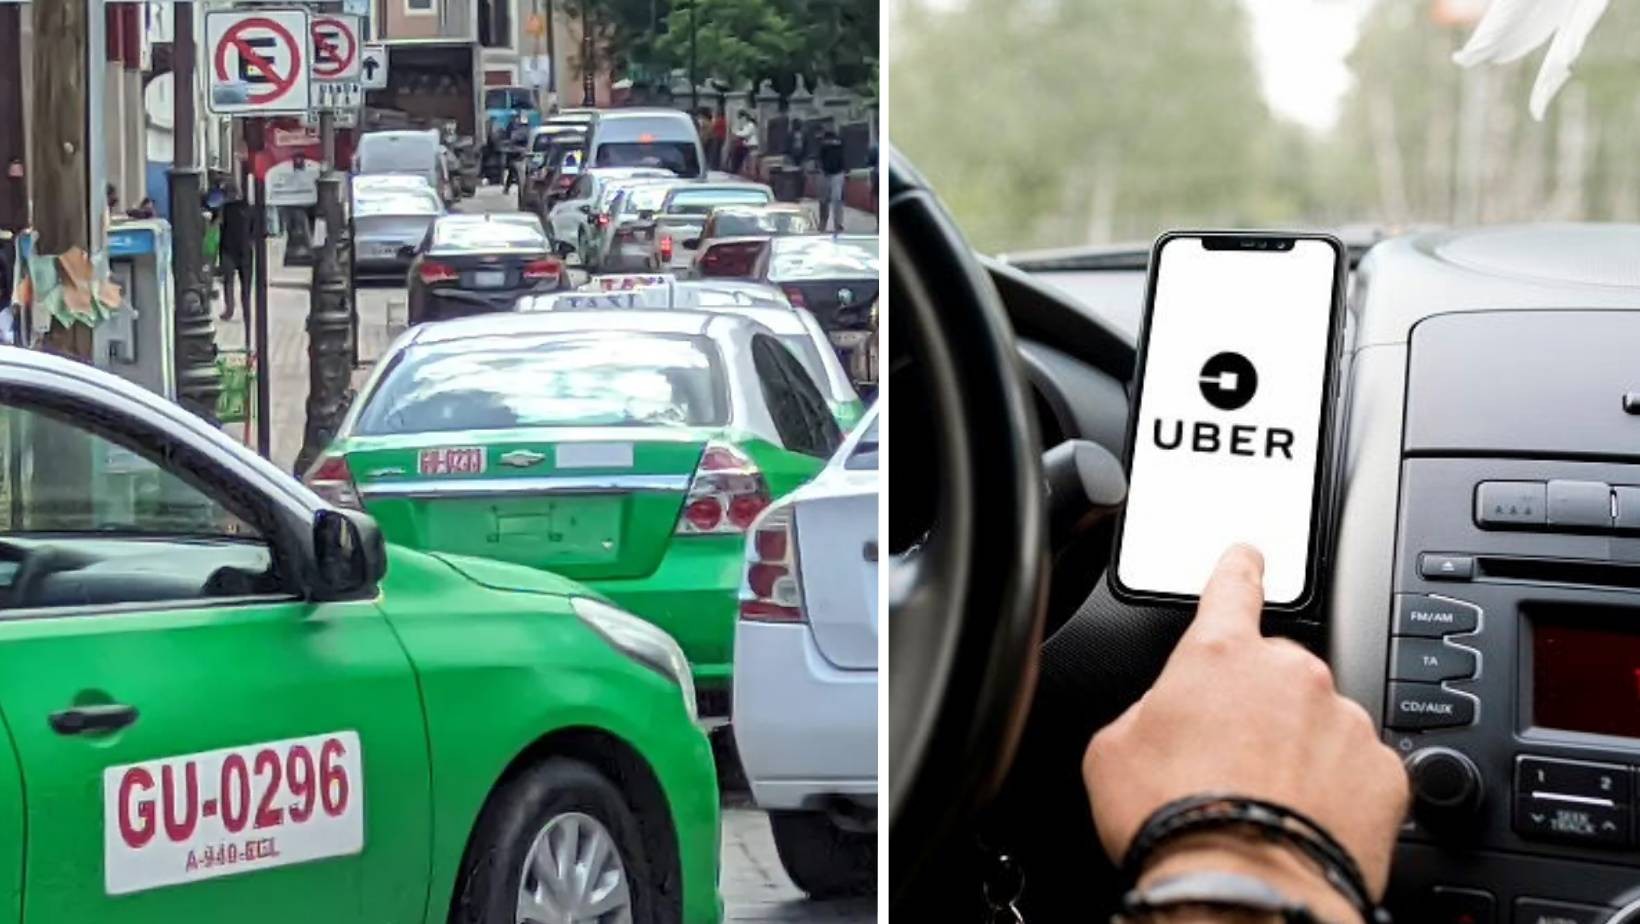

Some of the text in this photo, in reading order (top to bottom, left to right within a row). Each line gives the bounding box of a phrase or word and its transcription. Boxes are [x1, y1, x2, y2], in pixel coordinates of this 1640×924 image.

[1153, 418, 1294, 459] UBER
[1410, 611, 1453, 622] FM/AM
[1423, 656, 1438, 666] TA
[1401, 701, 1453, 713] CD/AUX
[1537, 769, 1612, 790] 1 2
[118, 738, 349, 849] GU-0296
